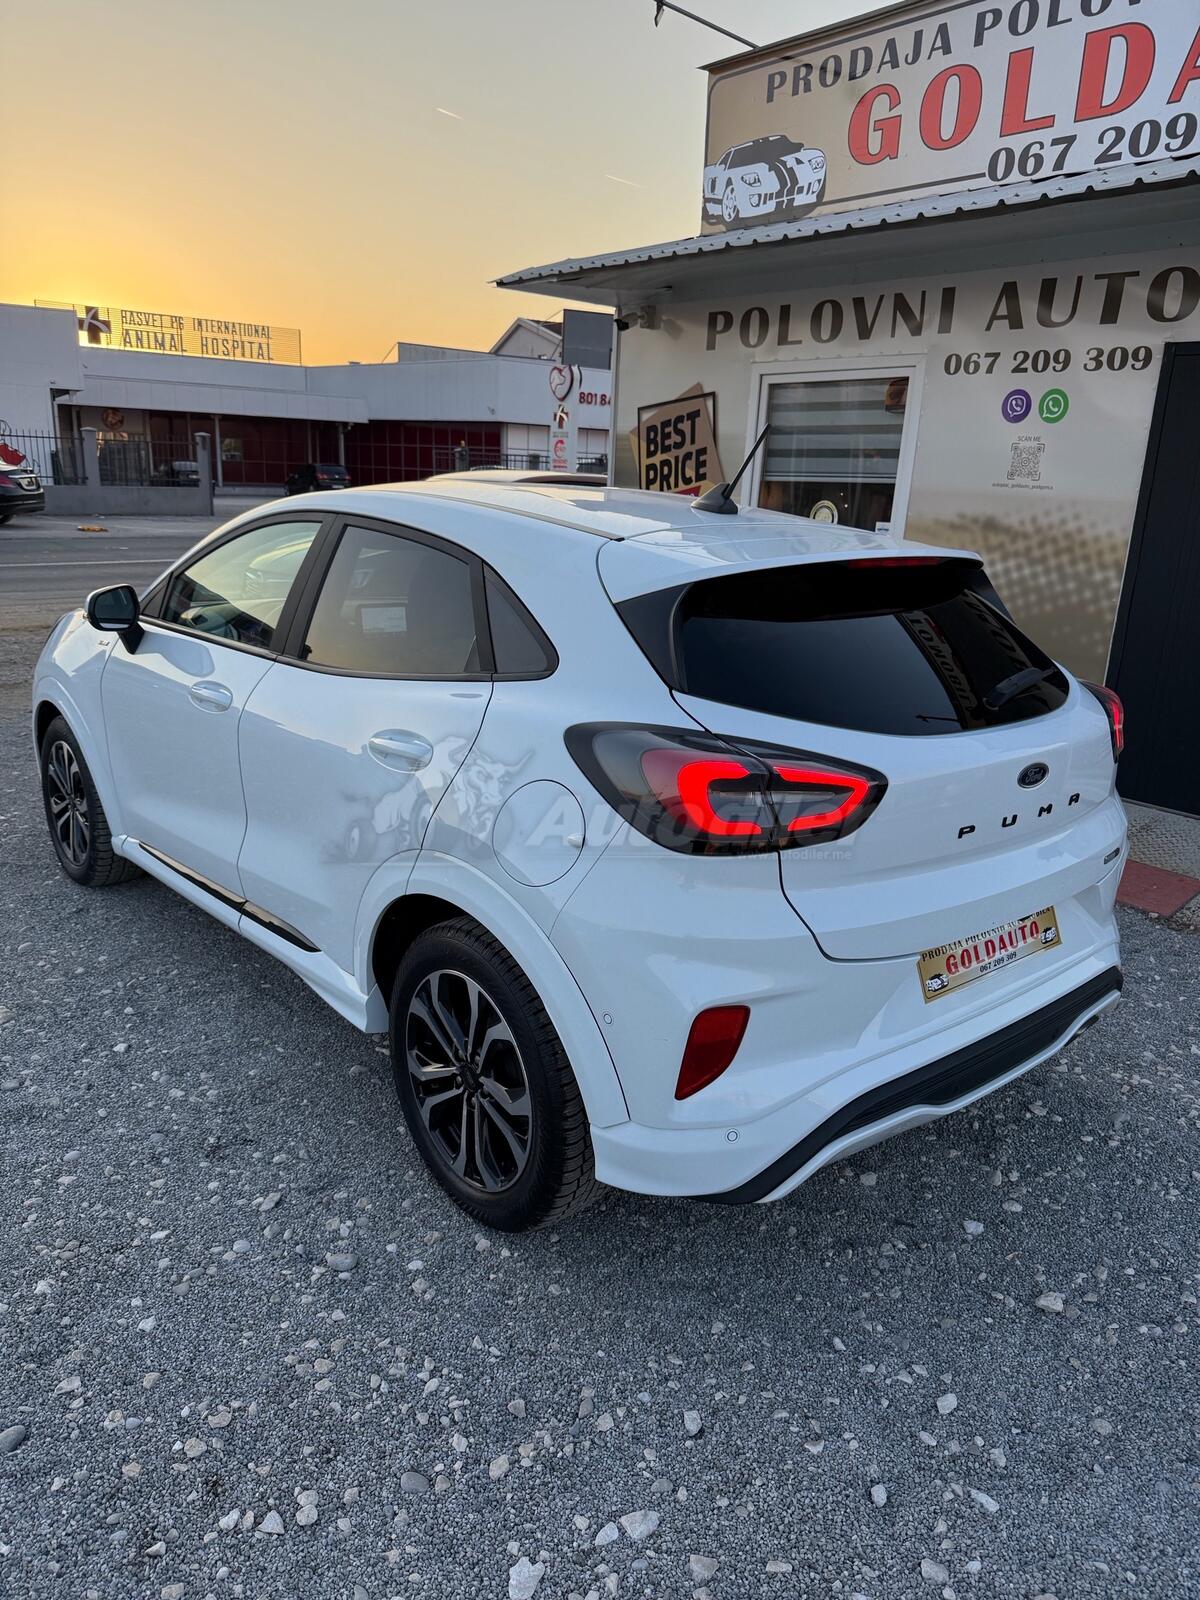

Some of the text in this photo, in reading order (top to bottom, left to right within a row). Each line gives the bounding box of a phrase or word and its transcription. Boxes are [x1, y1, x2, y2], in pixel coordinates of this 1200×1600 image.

[765, 22, 952, 104] PRODAJA
[987, 112, 1198, 182] 067 209
[121, 310, 164, 328] HASVET
[192, 317, 272, 340] INTERNATIONAL
[705, 266, 1200, 352] POLOVNI AUTO
[124, 329, 274, 361] ANIMAL HOSPITAL
[943, 345, 1153, 376] 067 209 309
[646, 408, 701, 459] BEST
[646, 447, 708, 493] PRICE
[957, 792, 1081, 839] PUMA
[922, 939, 963, 962] PRODAJA
[945, 920, 1040, 976] GOLDAUTO
[980, 951, 1017, 973] 067 209 309
